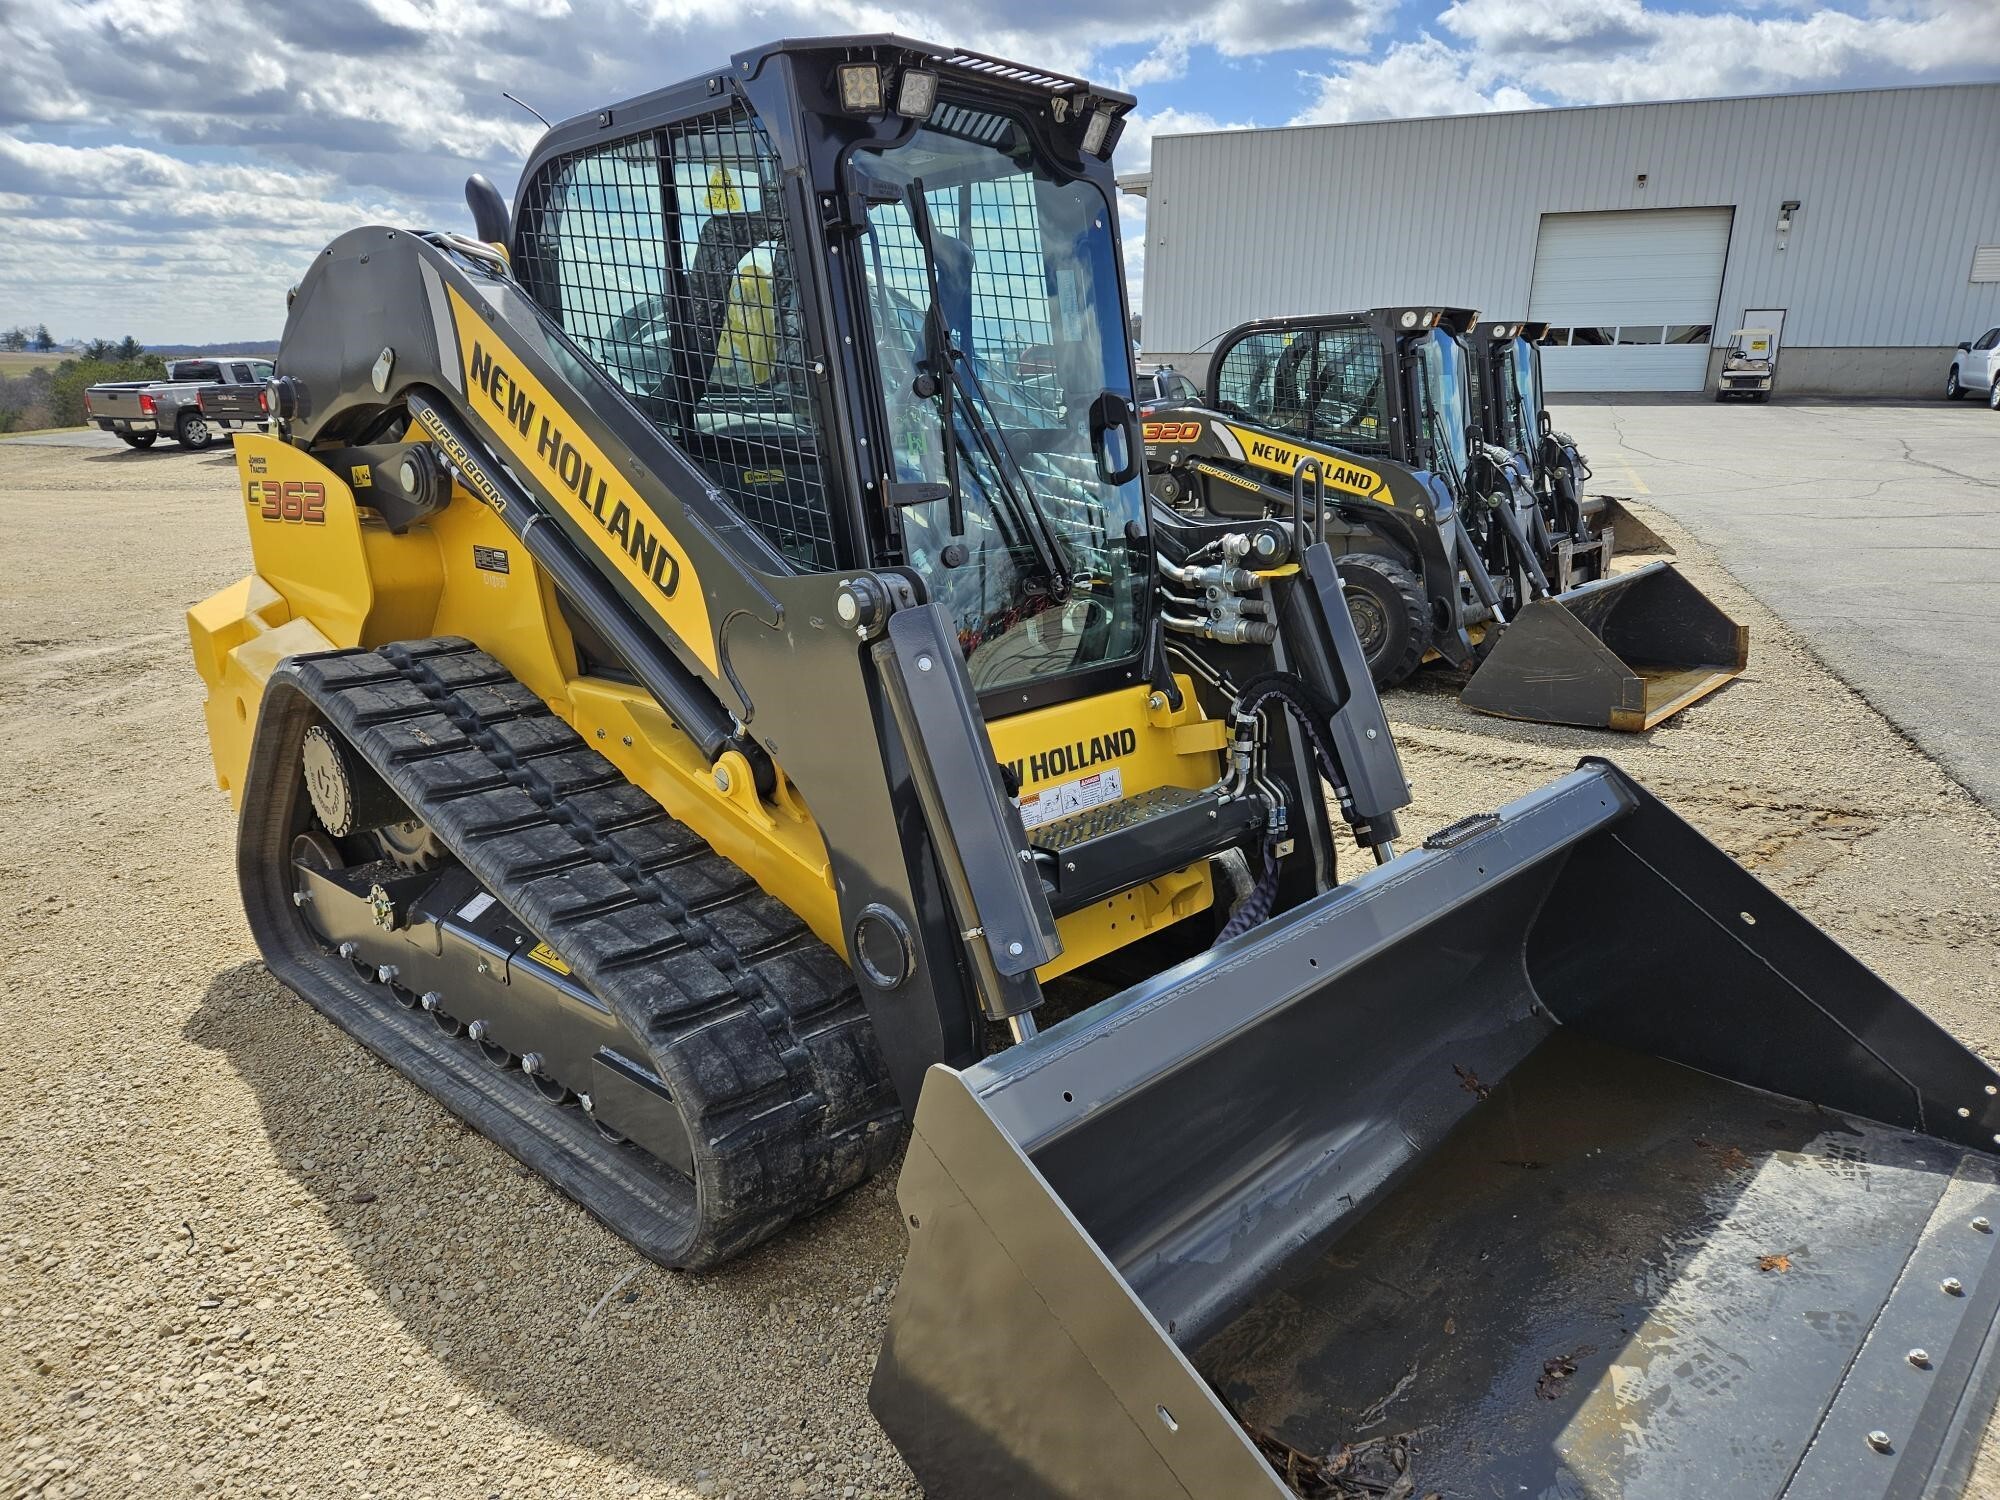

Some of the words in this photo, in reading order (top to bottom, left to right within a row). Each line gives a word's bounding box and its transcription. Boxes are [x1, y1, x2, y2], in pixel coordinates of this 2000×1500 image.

[470, 340, 536, 438] NEW
[536, 415, 681, 599] HOLLAND
[1252, 441, 1291, 465] NEW
[1292, 453, 1373, 490] OLAND
[1029, 727, 1137, 783] HOLLAND
